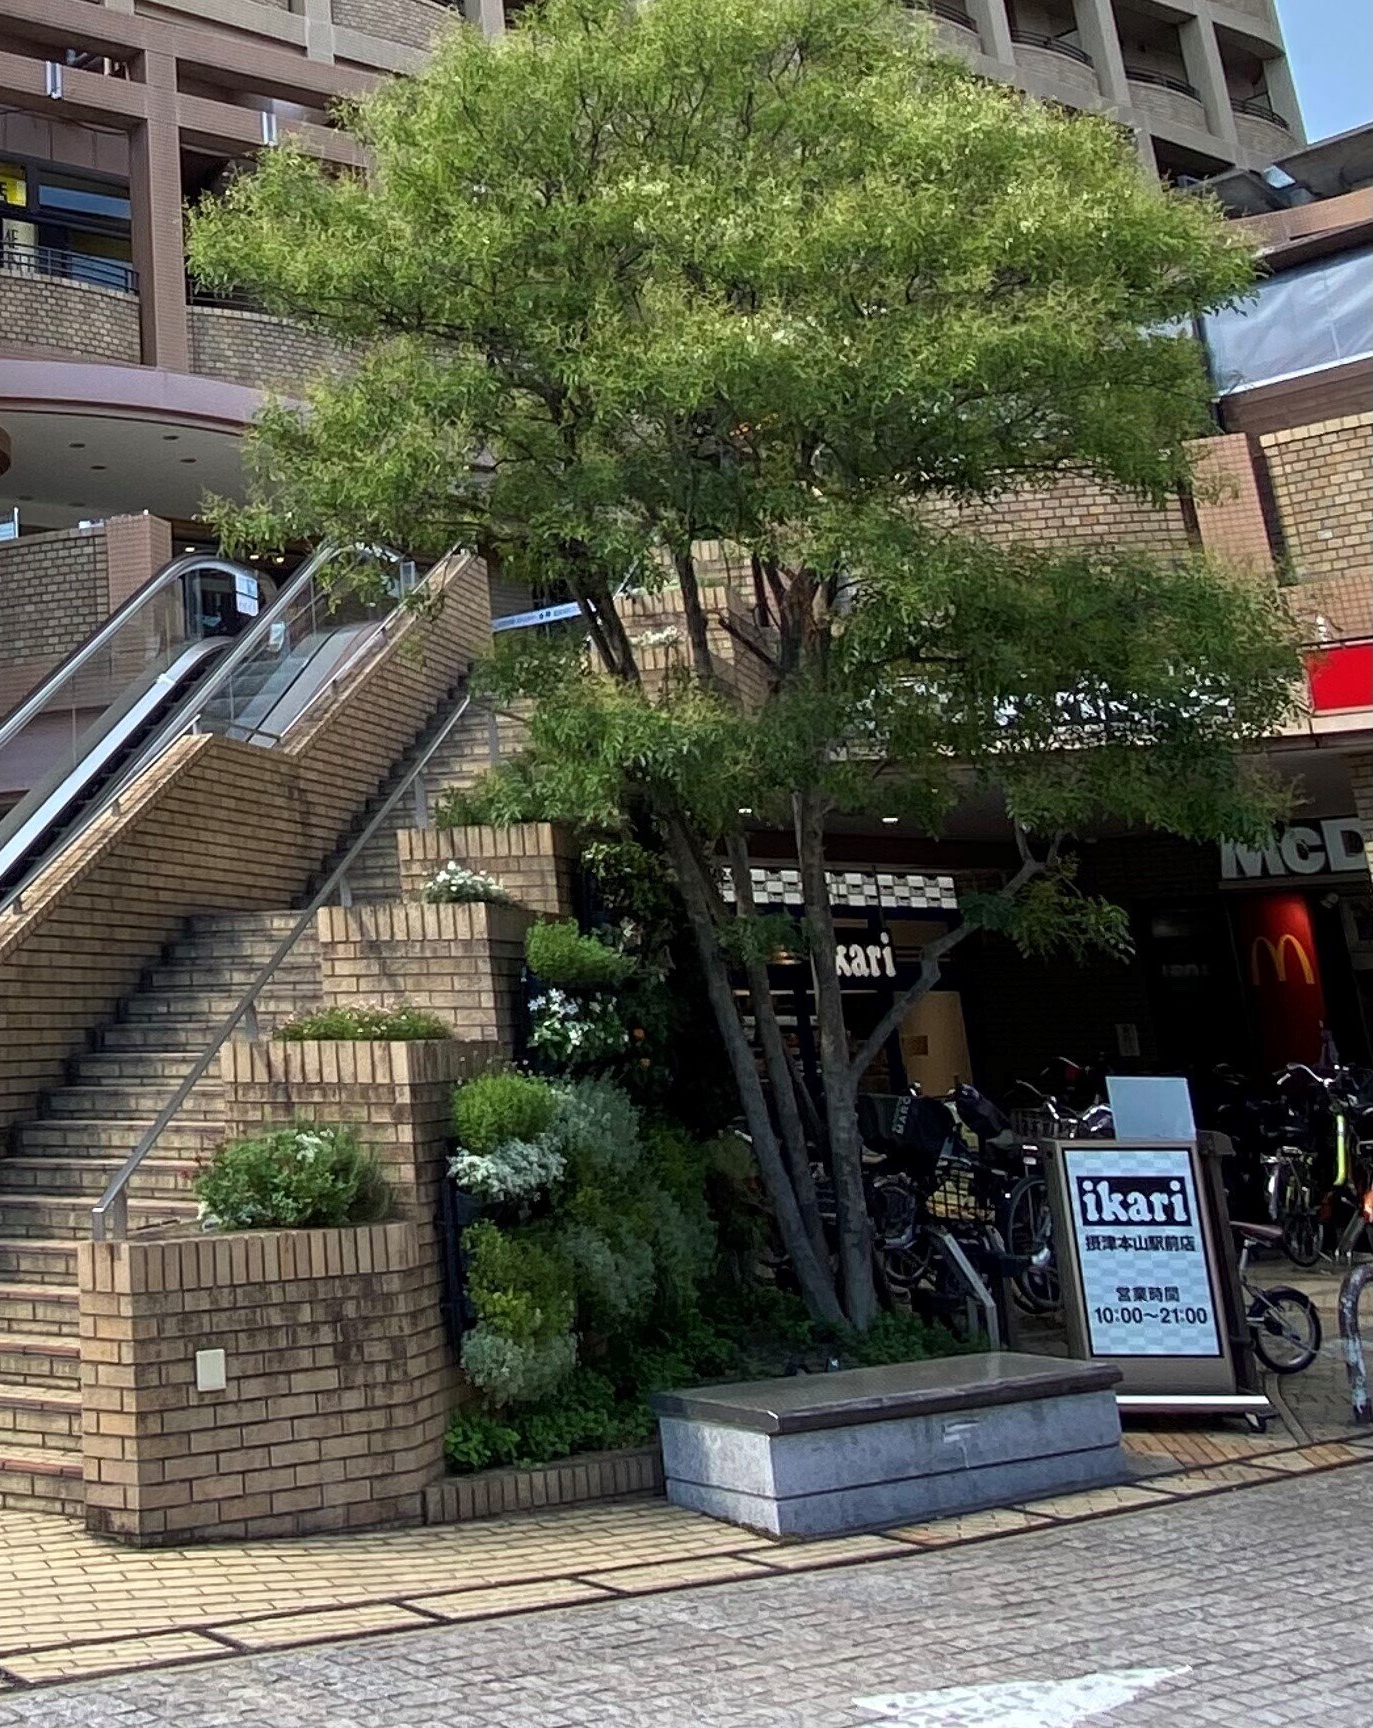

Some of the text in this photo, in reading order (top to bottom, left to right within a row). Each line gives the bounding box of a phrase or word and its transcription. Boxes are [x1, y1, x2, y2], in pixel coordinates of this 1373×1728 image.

[835, 931, 897, 978] kari
[1082, 1180, 1189, 1223] ikari
[1085, 1235, 1196, 1252] 摂津本山駅前店
[1115, 1286, 1181, 1303] 営業時間
